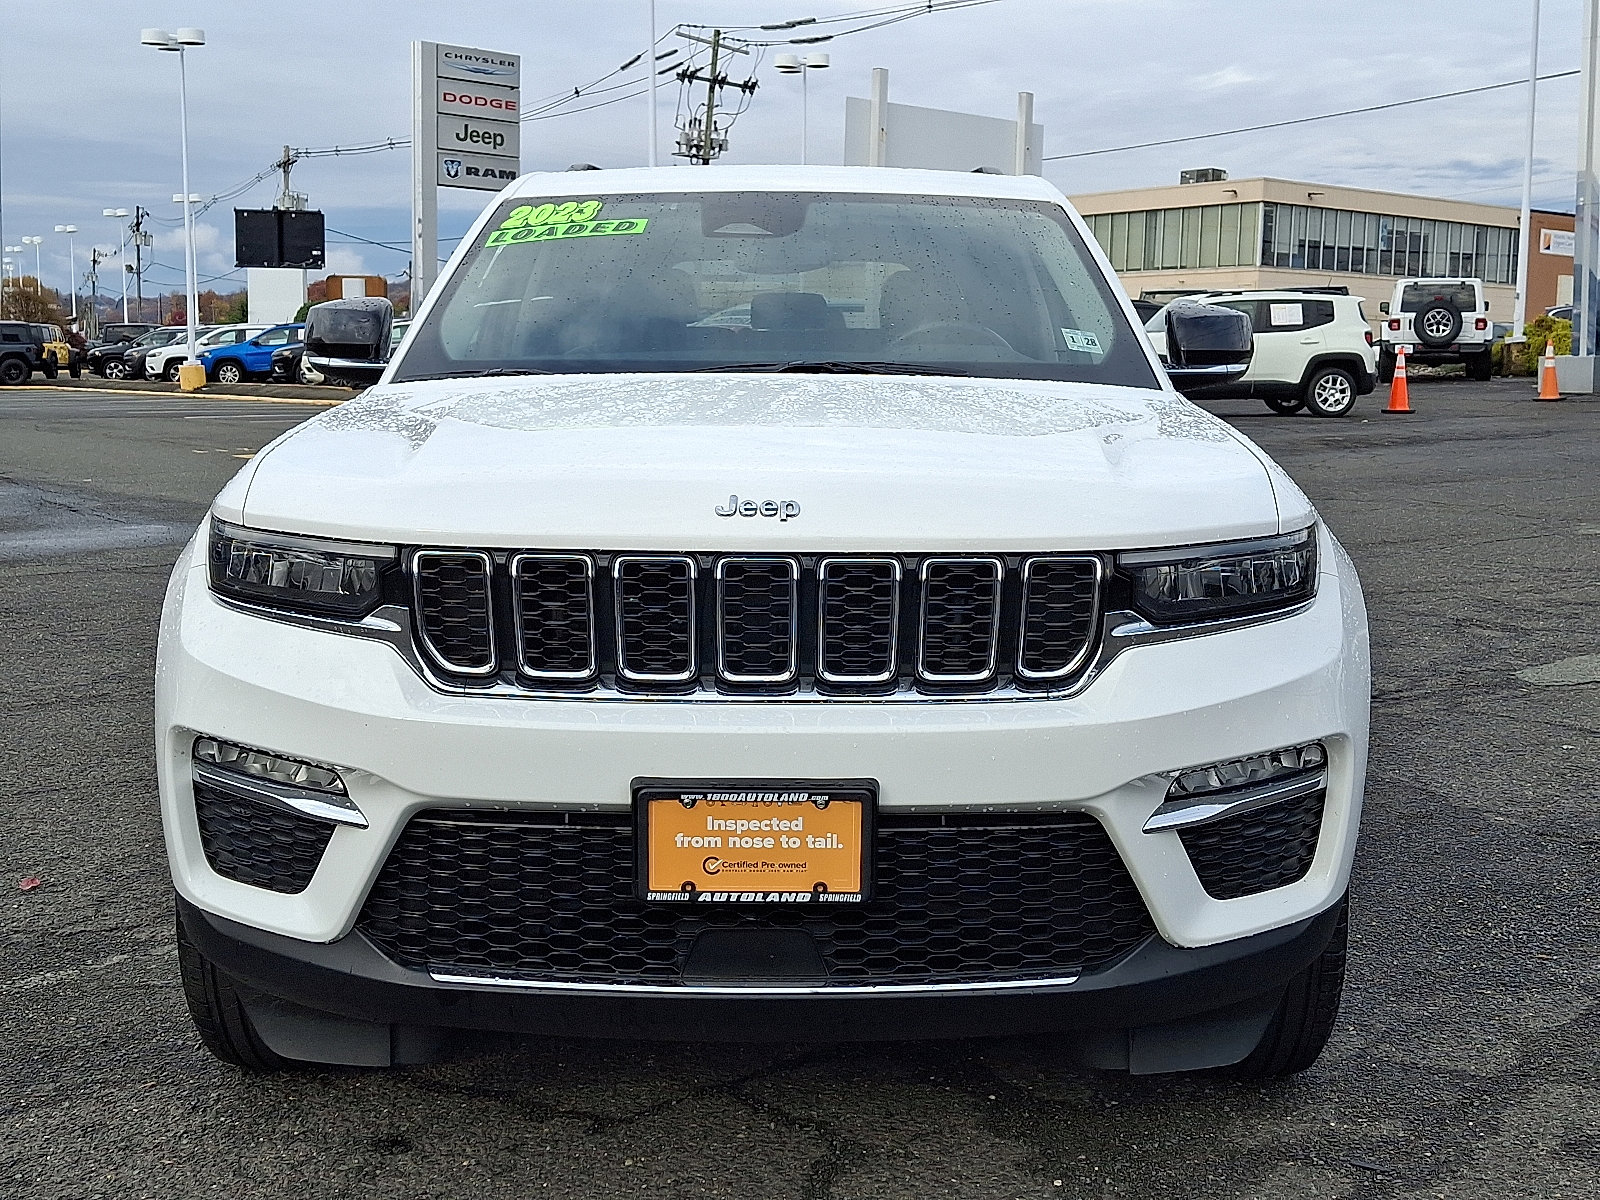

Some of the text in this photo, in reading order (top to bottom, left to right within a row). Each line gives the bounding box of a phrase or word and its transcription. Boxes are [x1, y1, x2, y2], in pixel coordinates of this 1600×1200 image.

[444, 52, 516, 68] CHRYSLER
[442, 91, 518, 111] DODGE
[455, 123, 505, 149] Jeep
[465, 165, 517, 180] RAM
[500, 200, 603, 229] 2023
[490, 220, 640, 244] LOADED
[1083, 337, 1097, 346] 28
[714, 494, 801, 522] Jeep
[680, 792, 829, 802] www.1800AUTOLAND.com
[706, 815, 804, 834] Inspected
[674, 832, 844, 849] from nose to tail.
[721, 860, 759, 869] Certified
[646, 892, 862, 902] SPRINGFIELD AUTOLAND SPRINGFIELD
